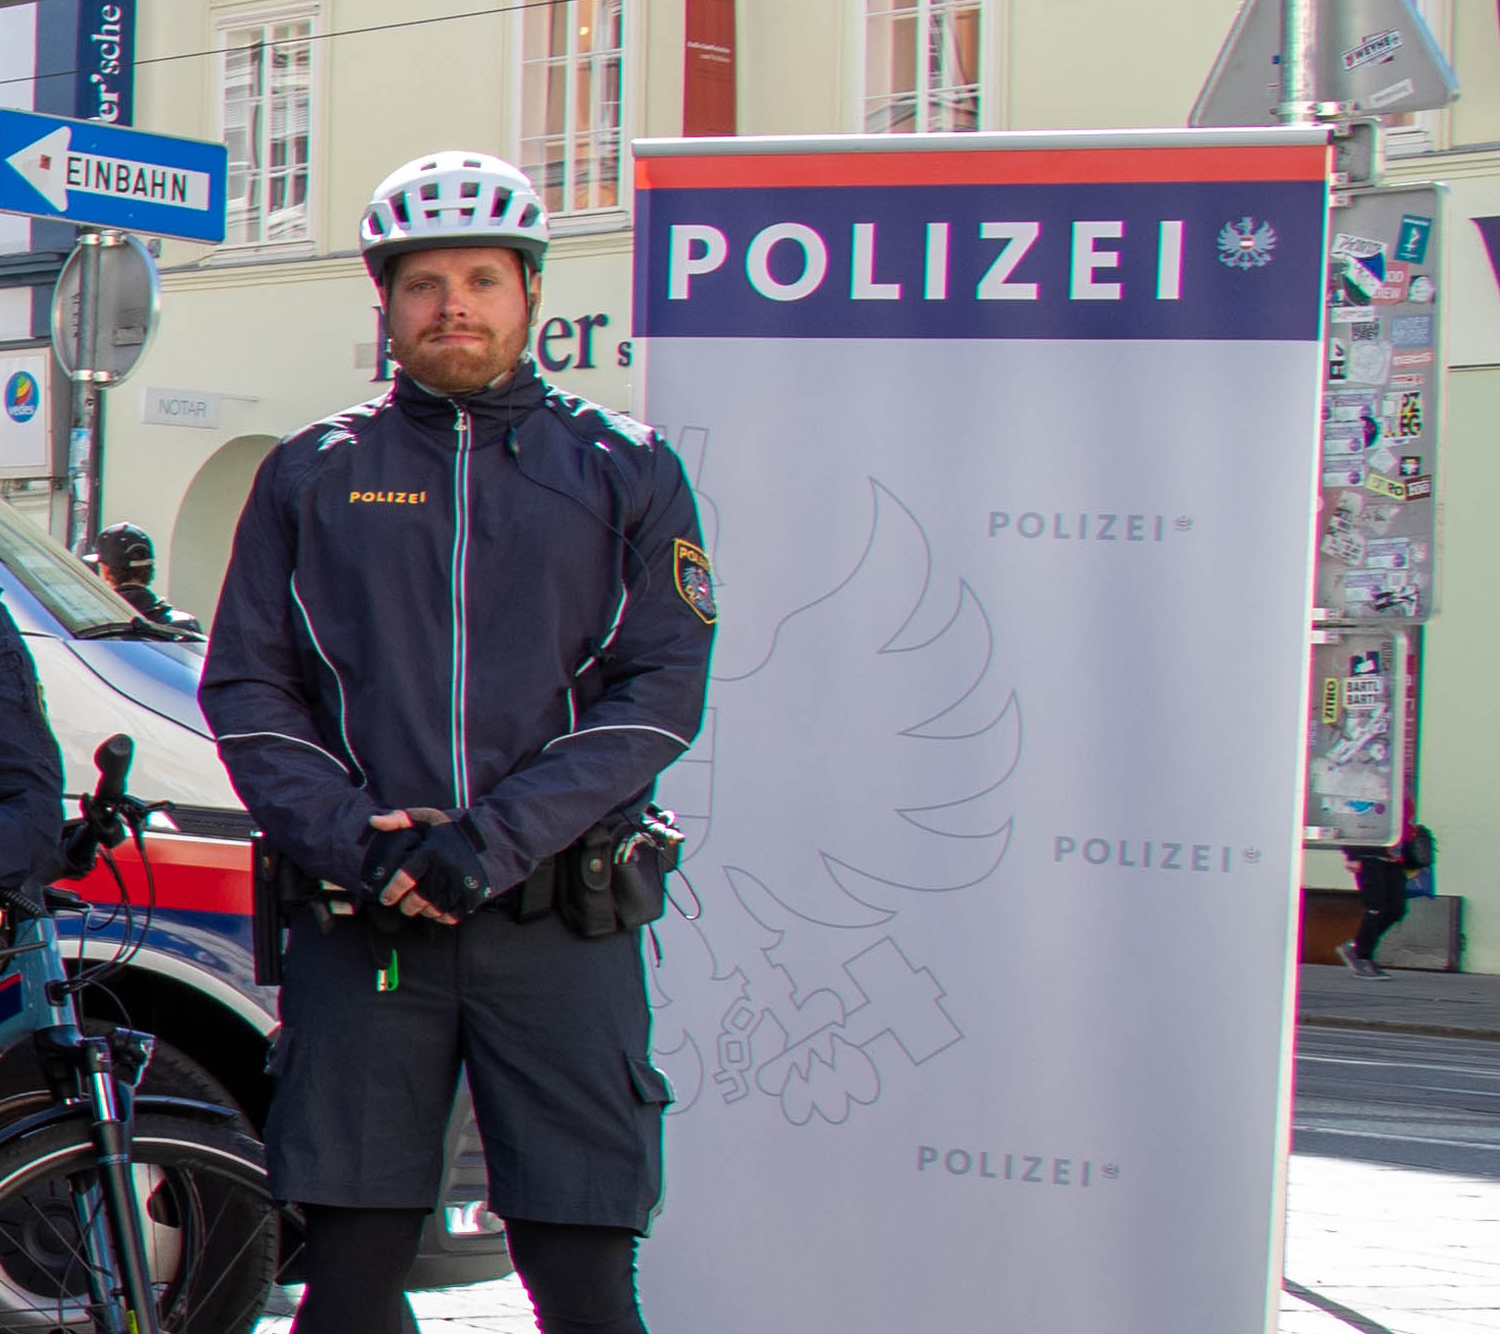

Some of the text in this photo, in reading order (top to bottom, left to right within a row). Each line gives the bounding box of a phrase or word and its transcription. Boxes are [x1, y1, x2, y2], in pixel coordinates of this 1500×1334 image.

[65, 151, 190, 205] EINBAHN
[666, 219, 1186, 302] POLIZEI
[158, 398, 208, 418] NOTAR
[348, 489, 428, 507] POLIZEI
[987, 511, 1166, 543] POLIZEI
[1053, 835, 1232, 874] POLIZEI
[916, 1143, 1091, 1188] POLIZEI
